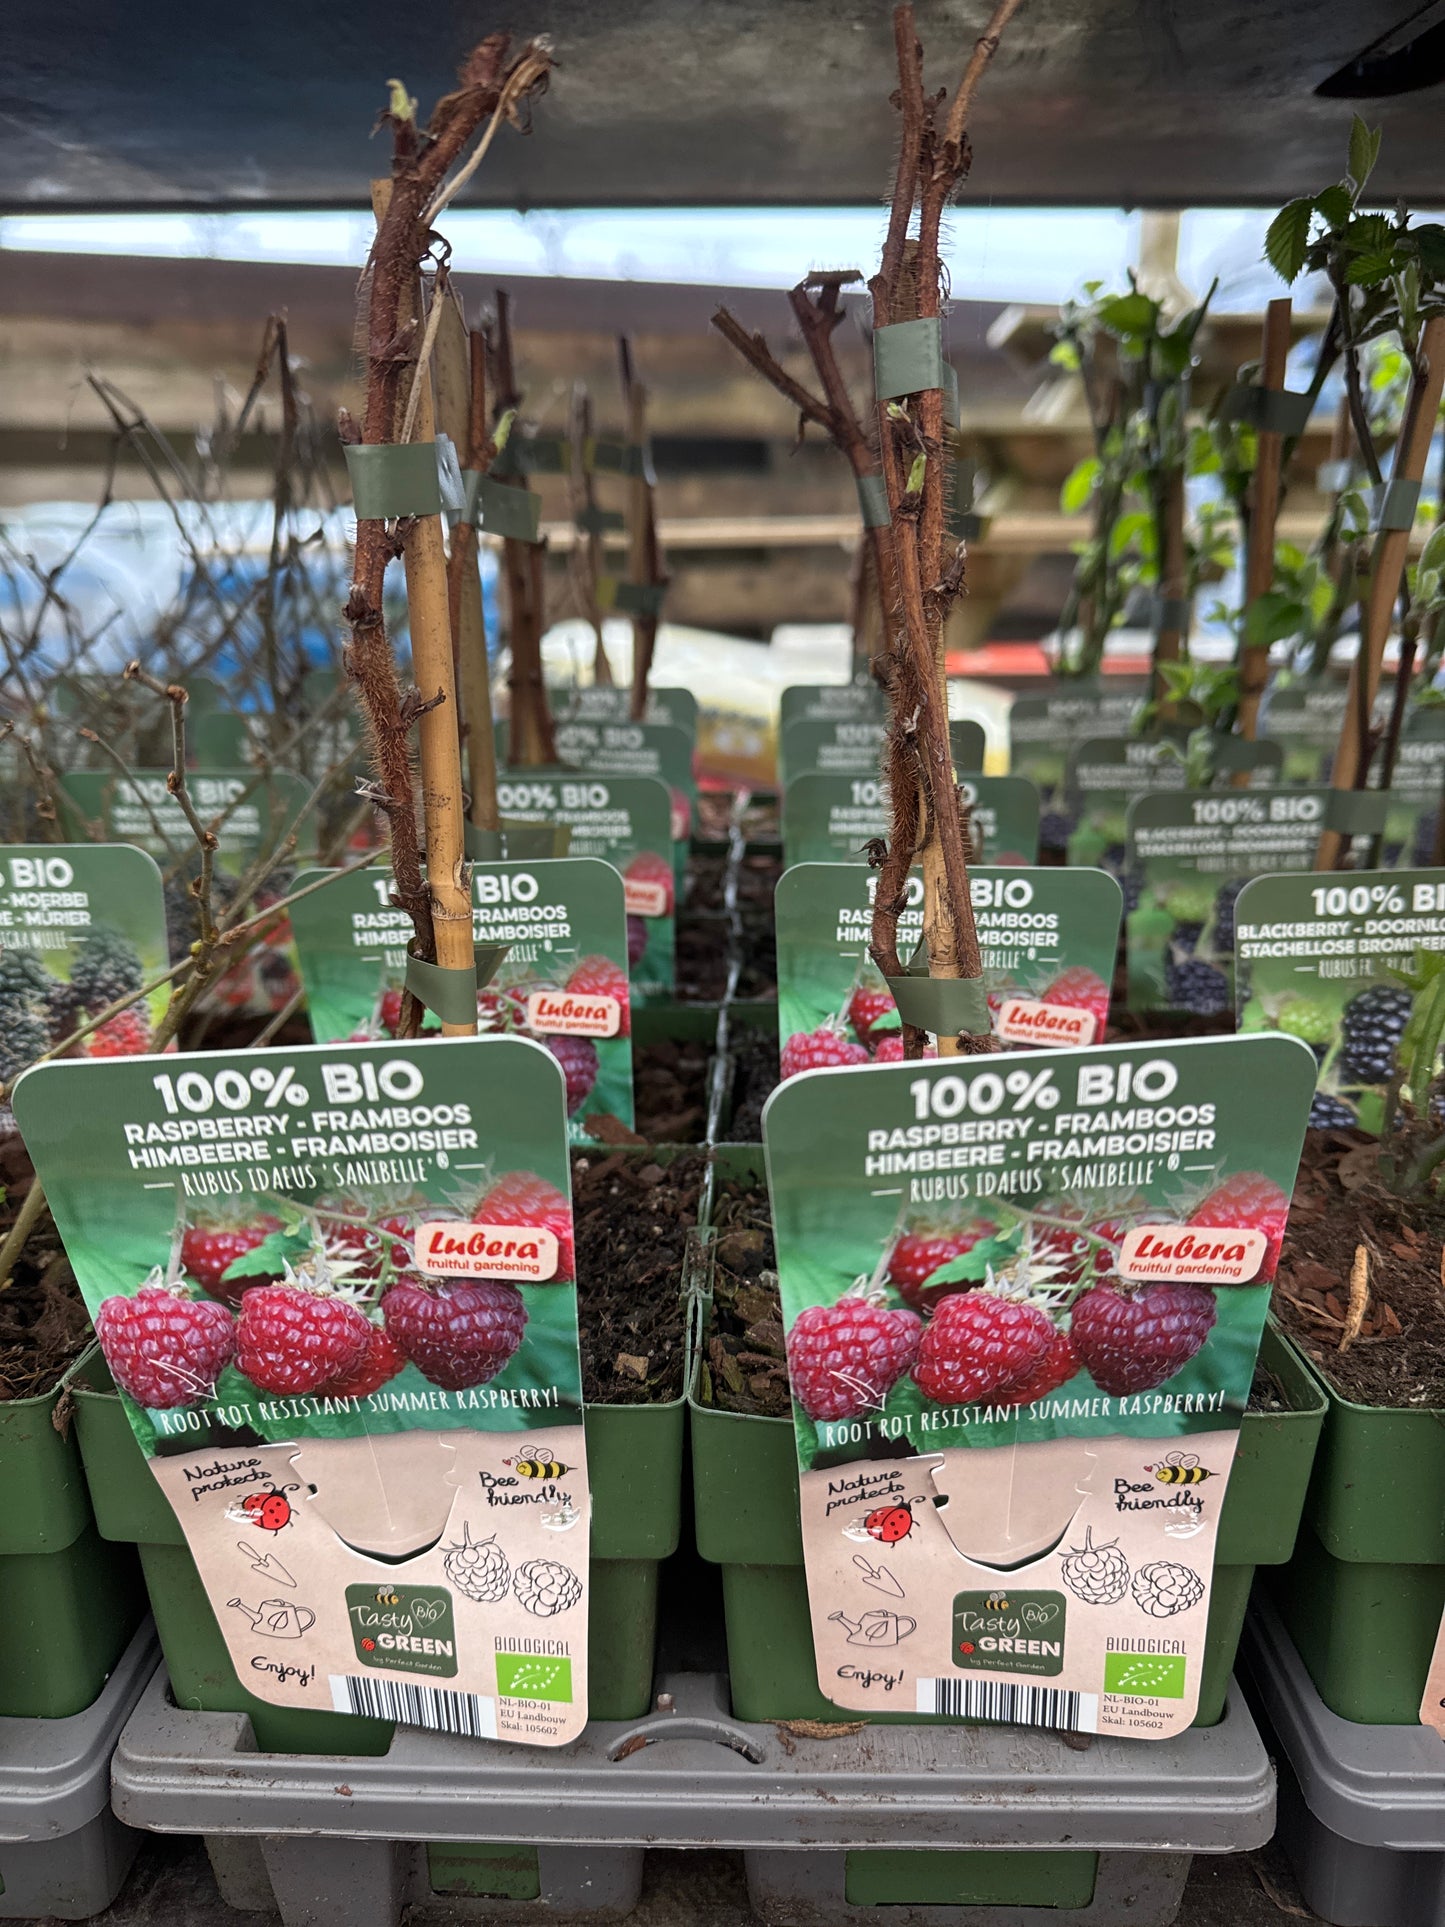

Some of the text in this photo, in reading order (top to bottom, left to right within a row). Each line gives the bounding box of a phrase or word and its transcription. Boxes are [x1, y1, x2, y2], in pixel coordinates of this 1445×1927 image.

[496, 783, 610, 809] 00% BIO
[1192, 795, 1324, 824] 100% BIO
[8, 857, 74, 888] BIO
[476, 873, 539, 904] BIO
[970, 878, 1034, 908] BIO
[1311, 884, 1406, 916] 100%
[1237, 921, 1350, 940] BLACKBERRY
[1240, 939, 1355, 959] STACHELLOSE
[1319, 958, 1357, 978] RUBUS
[153, 1059, 424, 1115] 100% BIO
[909, 1059, 1179, 1120] 100% BIO
[124, 1114, 290, 1145] RASPBERRY
[311, 1103, 472, 1133] FRAMBOOS
[867, 1116, 1036, 1151] RASPBERRY
[1054, 1104, 1217, 1136] FRAMBOOS
[127, 1140, 271, 1169] HIMBEERE
[291, 1129, 479, 1158] FRAMBOISIER
[865, 1144, 1005, 1176] HIMBEERE
[1027, 1129, 1217, 1162] FRAMBOISIER
[181, 1168, 243, 1198] RUBUS
[249, 1164, 318, 1193] IDAEUS
[910, 1172, 969, 1203] RUBUS
[976, 1167, 1043, 1197] IDAEUS
[427, 1258, 540, 1275] fruitful gardening
[1128, 1262, 1243, 1277] fruitful gardening
[160, 1385, 560, 1435] ROOT ROT RESISTANT SUMMER RASPBERRY!
[826, 1389, 1226, 1448] ROOT ROT RESISTANT SUMMER RASPBERRY!
[182, 1457, 262, 1483] Nature
[480, 1471, 520, 1488] Bee
[827, 1468, 903, 1497] Nature
[191, 1468, 272, 1501] protects
[485, 1486, 572, 1507] friendly
[1114, 1478, 1154, 1495] Bee
[825, 1482, 906, 1516] protects
[1114, 1490, 1206, 1514] friendly
[350, 1605, 438, 1637] Tasty BIO
[955, 1609, 1049, 1639] Tasty BIO
[377, 1633, 454, 1656] GREEN
[494, 1636, 571, 1656] BIOLOGICAL
[978, 1636, 1061, 1657] GREEN
[1106, 1637, 1187, 1655] BIOLOGICAL
[250, 1655, 316, 1687] Enjoy!
[982, 1658, 1014, 1669] Perfect
[836, 1665, 905, 1691] Enjoy!
[499, 1697, 552, 1711] NL-BIO-01
[1103, 1694, 1160, 1707] NL-BIO-01
[1103, 1704, 1175, 1719] EU Landbouw
[500, 1708, 567, 1725] EU Landbouw
[501, 1721, 558, 1735] Skal: 105602
[1102, 1715, 1163, 1729] Skal: 105602
